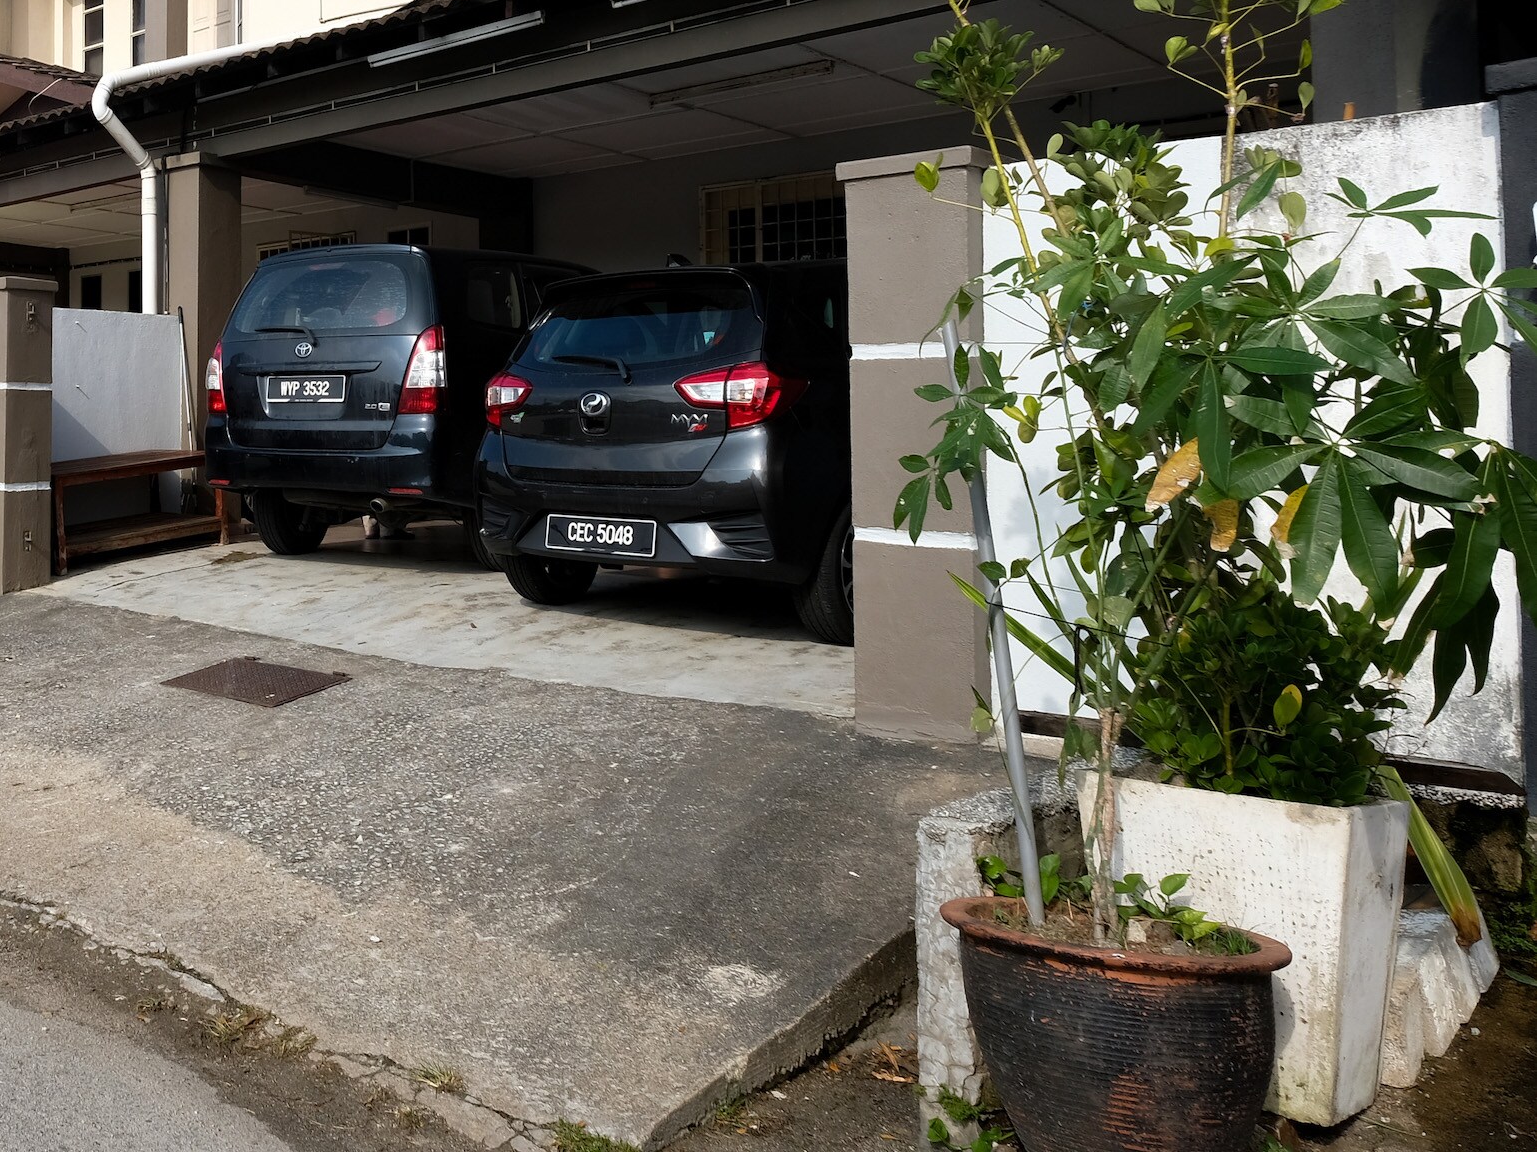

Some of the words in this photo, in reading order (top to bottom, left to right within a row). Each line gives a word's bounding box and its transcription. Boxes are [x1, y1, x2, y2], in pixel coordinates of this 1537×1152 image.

[280, 381, 300, 396] WYP
[303, 381, 330, 396] 3532
[567, 522, 594, 542] CEC
[596, 523, 634, 545] 5048
